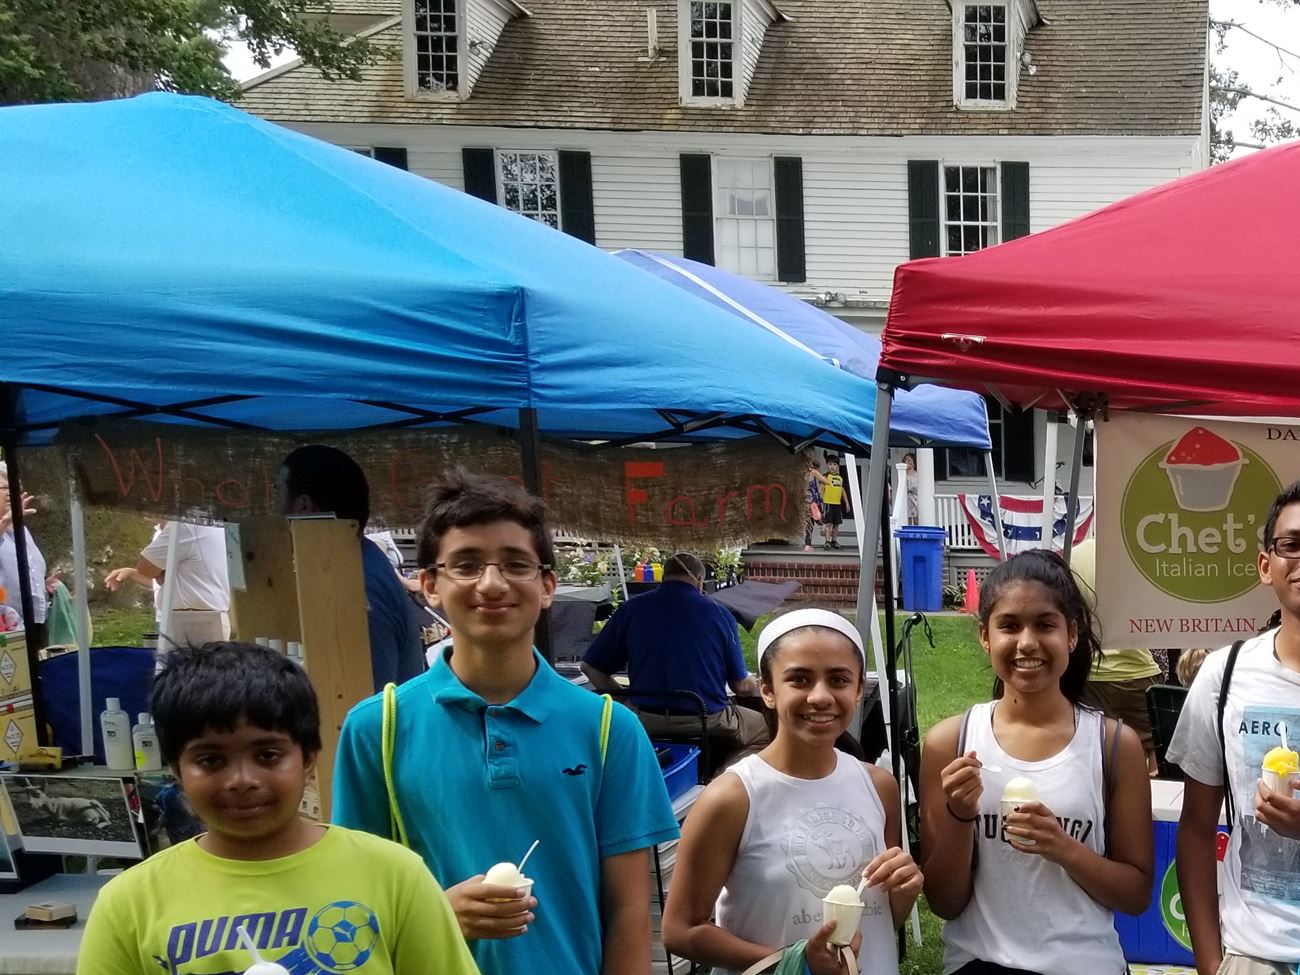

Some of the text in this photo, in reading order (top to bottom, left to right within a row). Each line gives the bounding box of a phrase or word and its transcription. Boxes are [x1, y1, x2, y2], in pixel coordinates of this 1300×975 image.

[624, 461, 788, 528] Farm
[1155, 558, 1258, 577] Italian Ice
[1129, 618, 1172, 633] NEW
